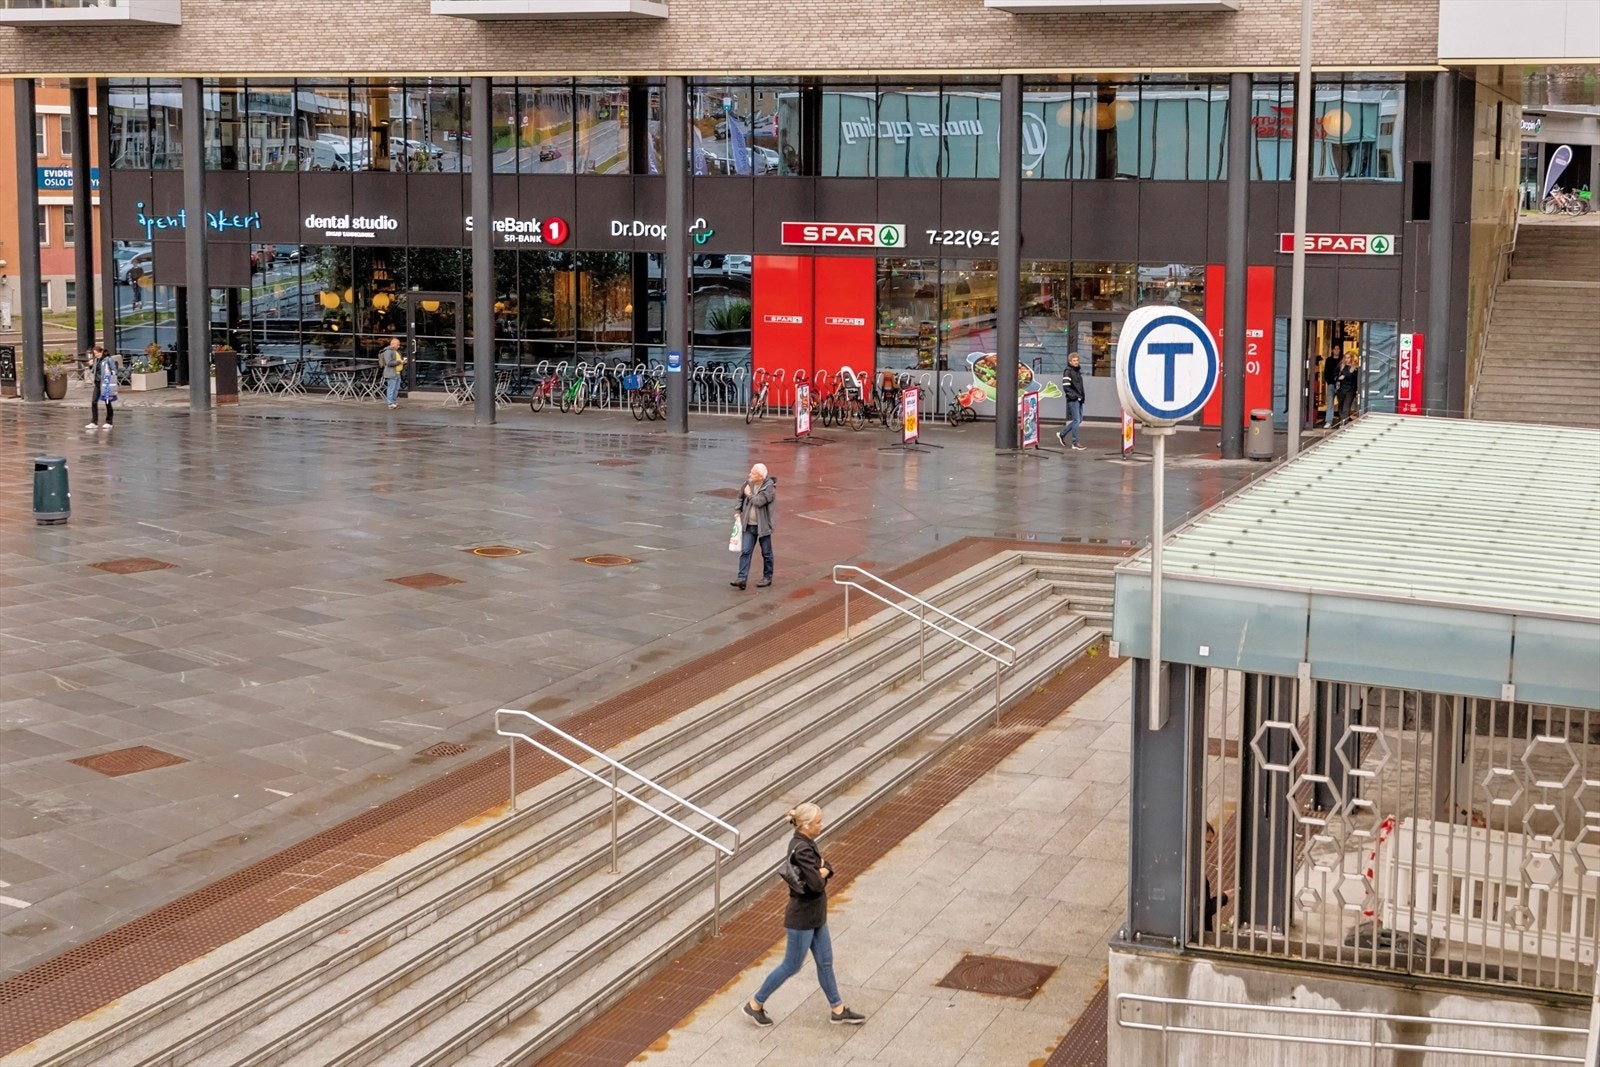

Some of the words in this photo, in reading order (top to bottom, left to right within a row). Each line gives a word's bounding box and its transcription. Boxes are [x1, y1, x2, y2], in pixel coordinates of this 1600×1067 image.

[44, 169, 73, 178] EVIDEN
[44, 178, 66, 187] OSLO
[137, 201, 186, 240] åpent
[206, 209, 261, 232] akeri
[305, 213, 350, 229] dental
[352, 215, 398, 230] studio
[465, 216, 542, 233] SreBank
[504, 234, 542, 243] SR-BANK
[611, 220, 667, 241] Dr.Drop
[803, 226, 874, 243] SPAR
[926, 229, 1000, 249] 7-22(9-2
[1303, 236, 1366, 251] SPAR
[1147, 342, 1194, 402] T
[1401, 350, 1411, 389] SPAR
